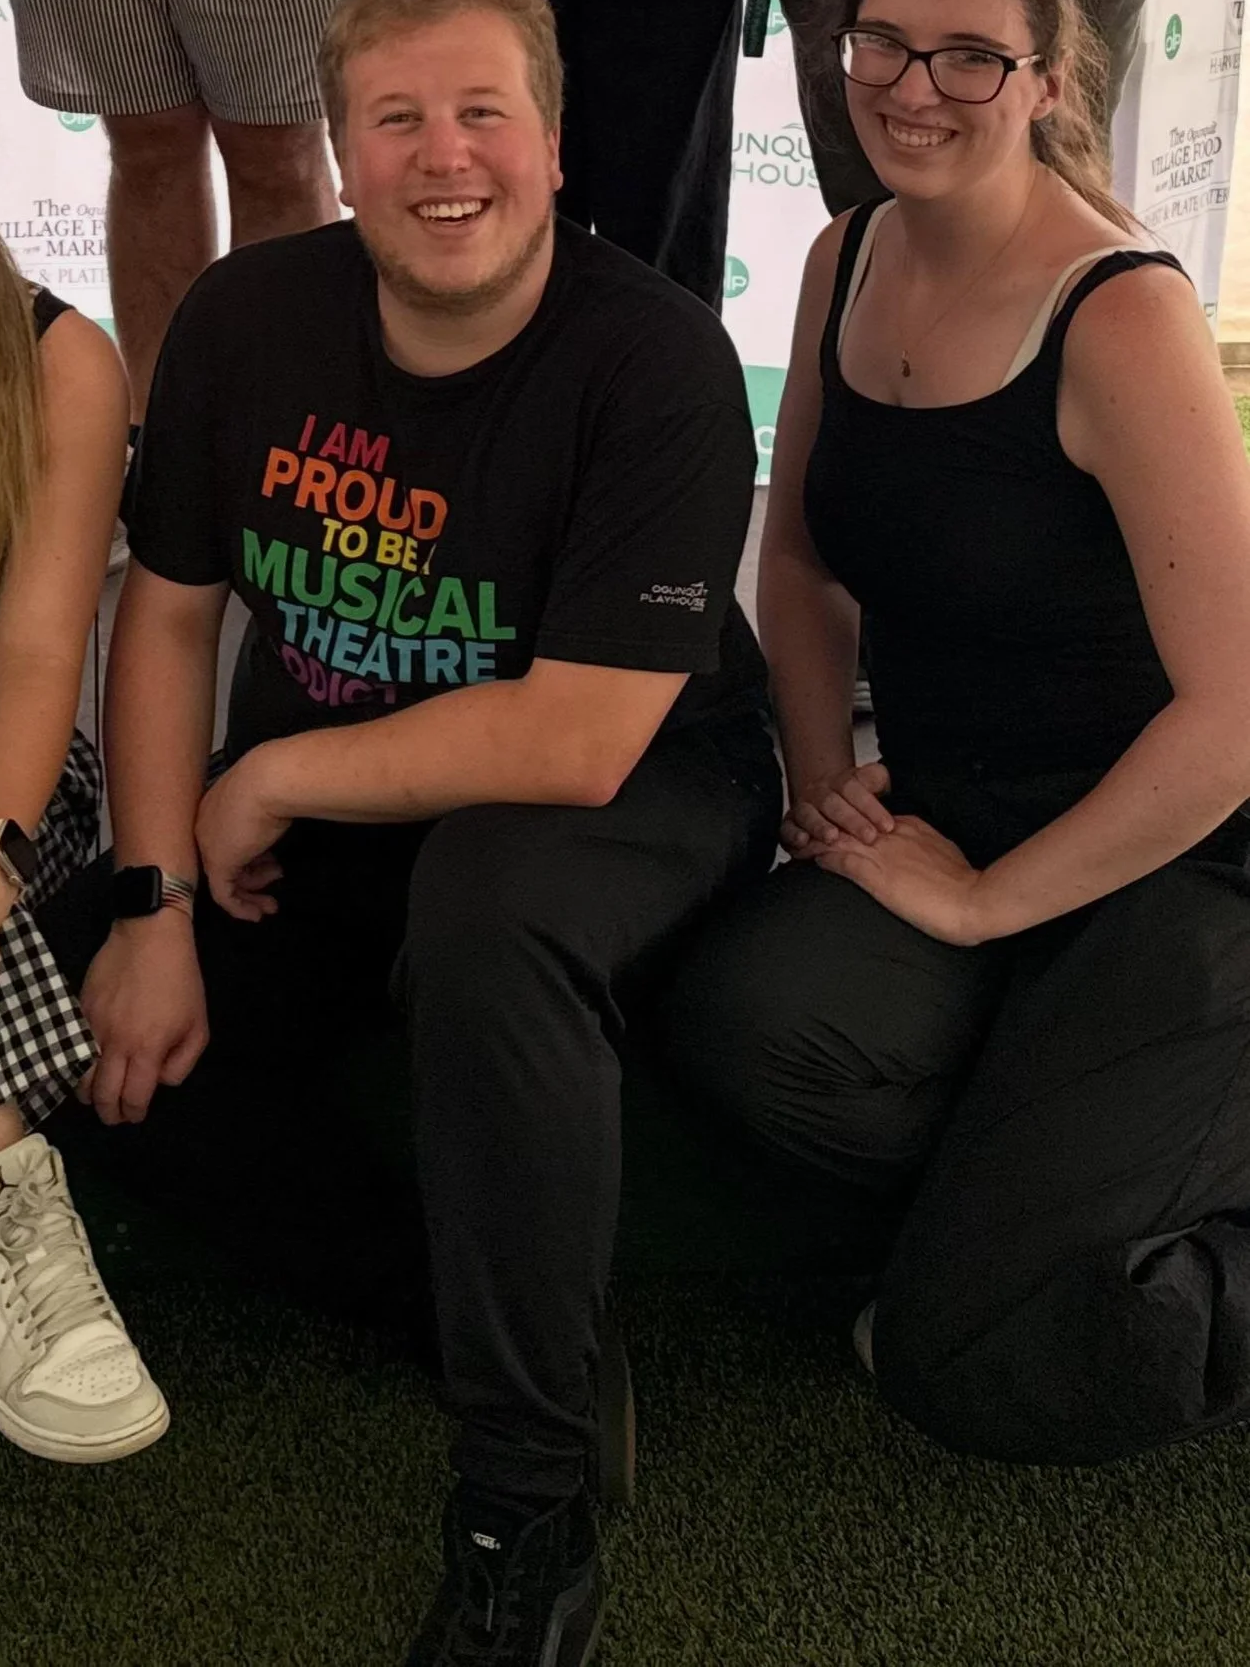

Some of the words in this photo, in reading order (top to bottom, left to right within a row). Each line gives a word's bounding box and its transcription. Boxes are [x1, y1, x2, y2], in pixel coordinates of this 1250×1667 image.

[0, 219, 85, 240] ILLAGE
[33, 199, 71, 218] The
[298, 414, 316, 452] I
[319, 422, 391, 473] AM
[261, 446, 448, 541] PROUD
[321, 517, 368, 559] TO
[376, 530, 418, 570] BE
[242, 527, 517, 641] MUSICAL
[639, 592, 707, 608] PLAYHOUSE
[276, 599, 497, 684] THEATRE
[280, 643, 397, 708] DDICT
